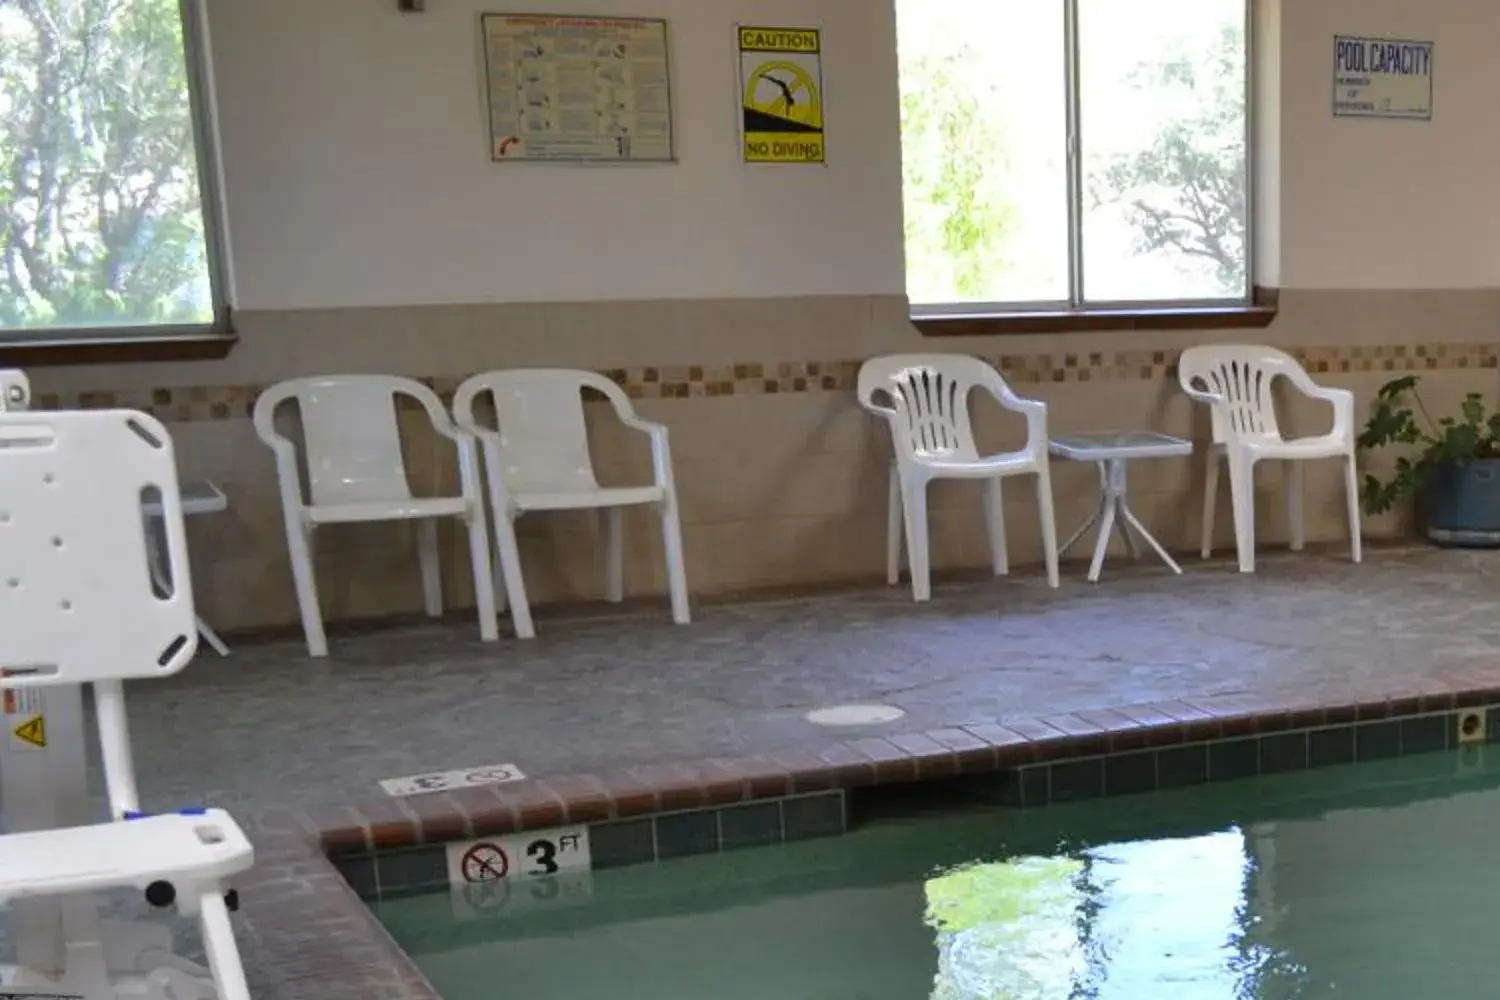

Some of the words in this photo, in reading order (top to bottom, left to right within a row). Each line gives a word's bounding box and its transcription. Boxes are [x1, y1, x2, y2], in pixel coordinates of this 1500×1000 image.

[743, 31, 816, 48] CAUTION
[1337, 41, 1369, 73] POOL
[1370, 43, 1429, 77] CAPACITY
[747, 142, 769, 156] NO
[772, 142, 820, 159] DIVING
[526, 839, 559, 875] 3
[559, 834, 582, 852] FT
